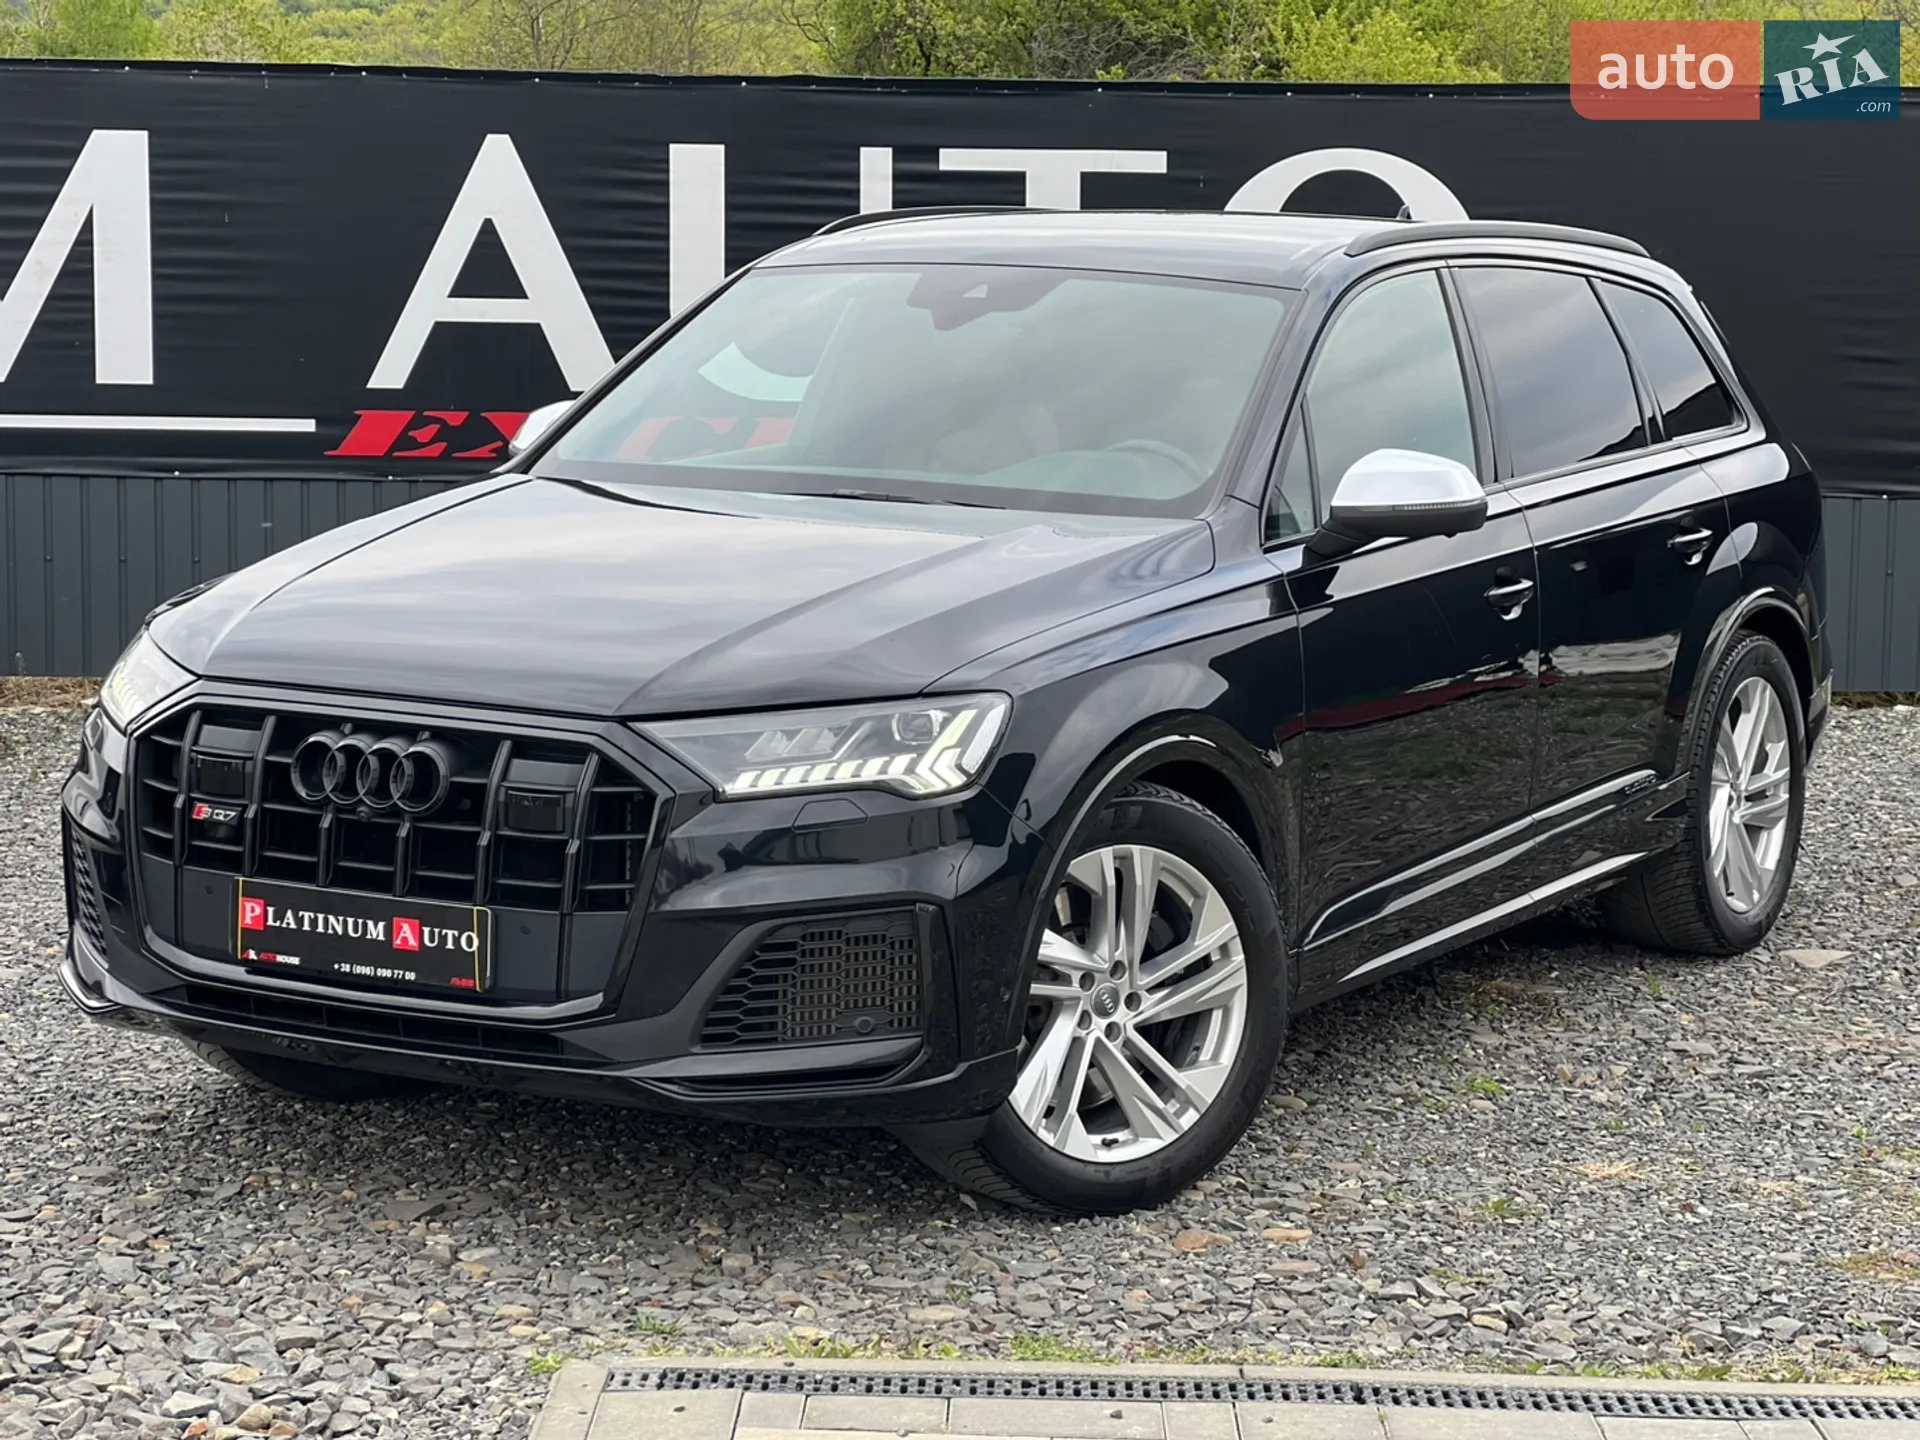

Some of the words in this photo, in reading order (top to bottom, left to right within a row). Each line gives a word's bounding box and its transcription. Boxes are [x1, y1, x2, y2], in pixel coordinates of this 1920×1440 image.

[366, 133, 1470, 397] AU
[194, 804, 237, 822] SQ7
[243, 901, 386, 941] PLATINUM
[394, 921, 479, 952] AUTO
